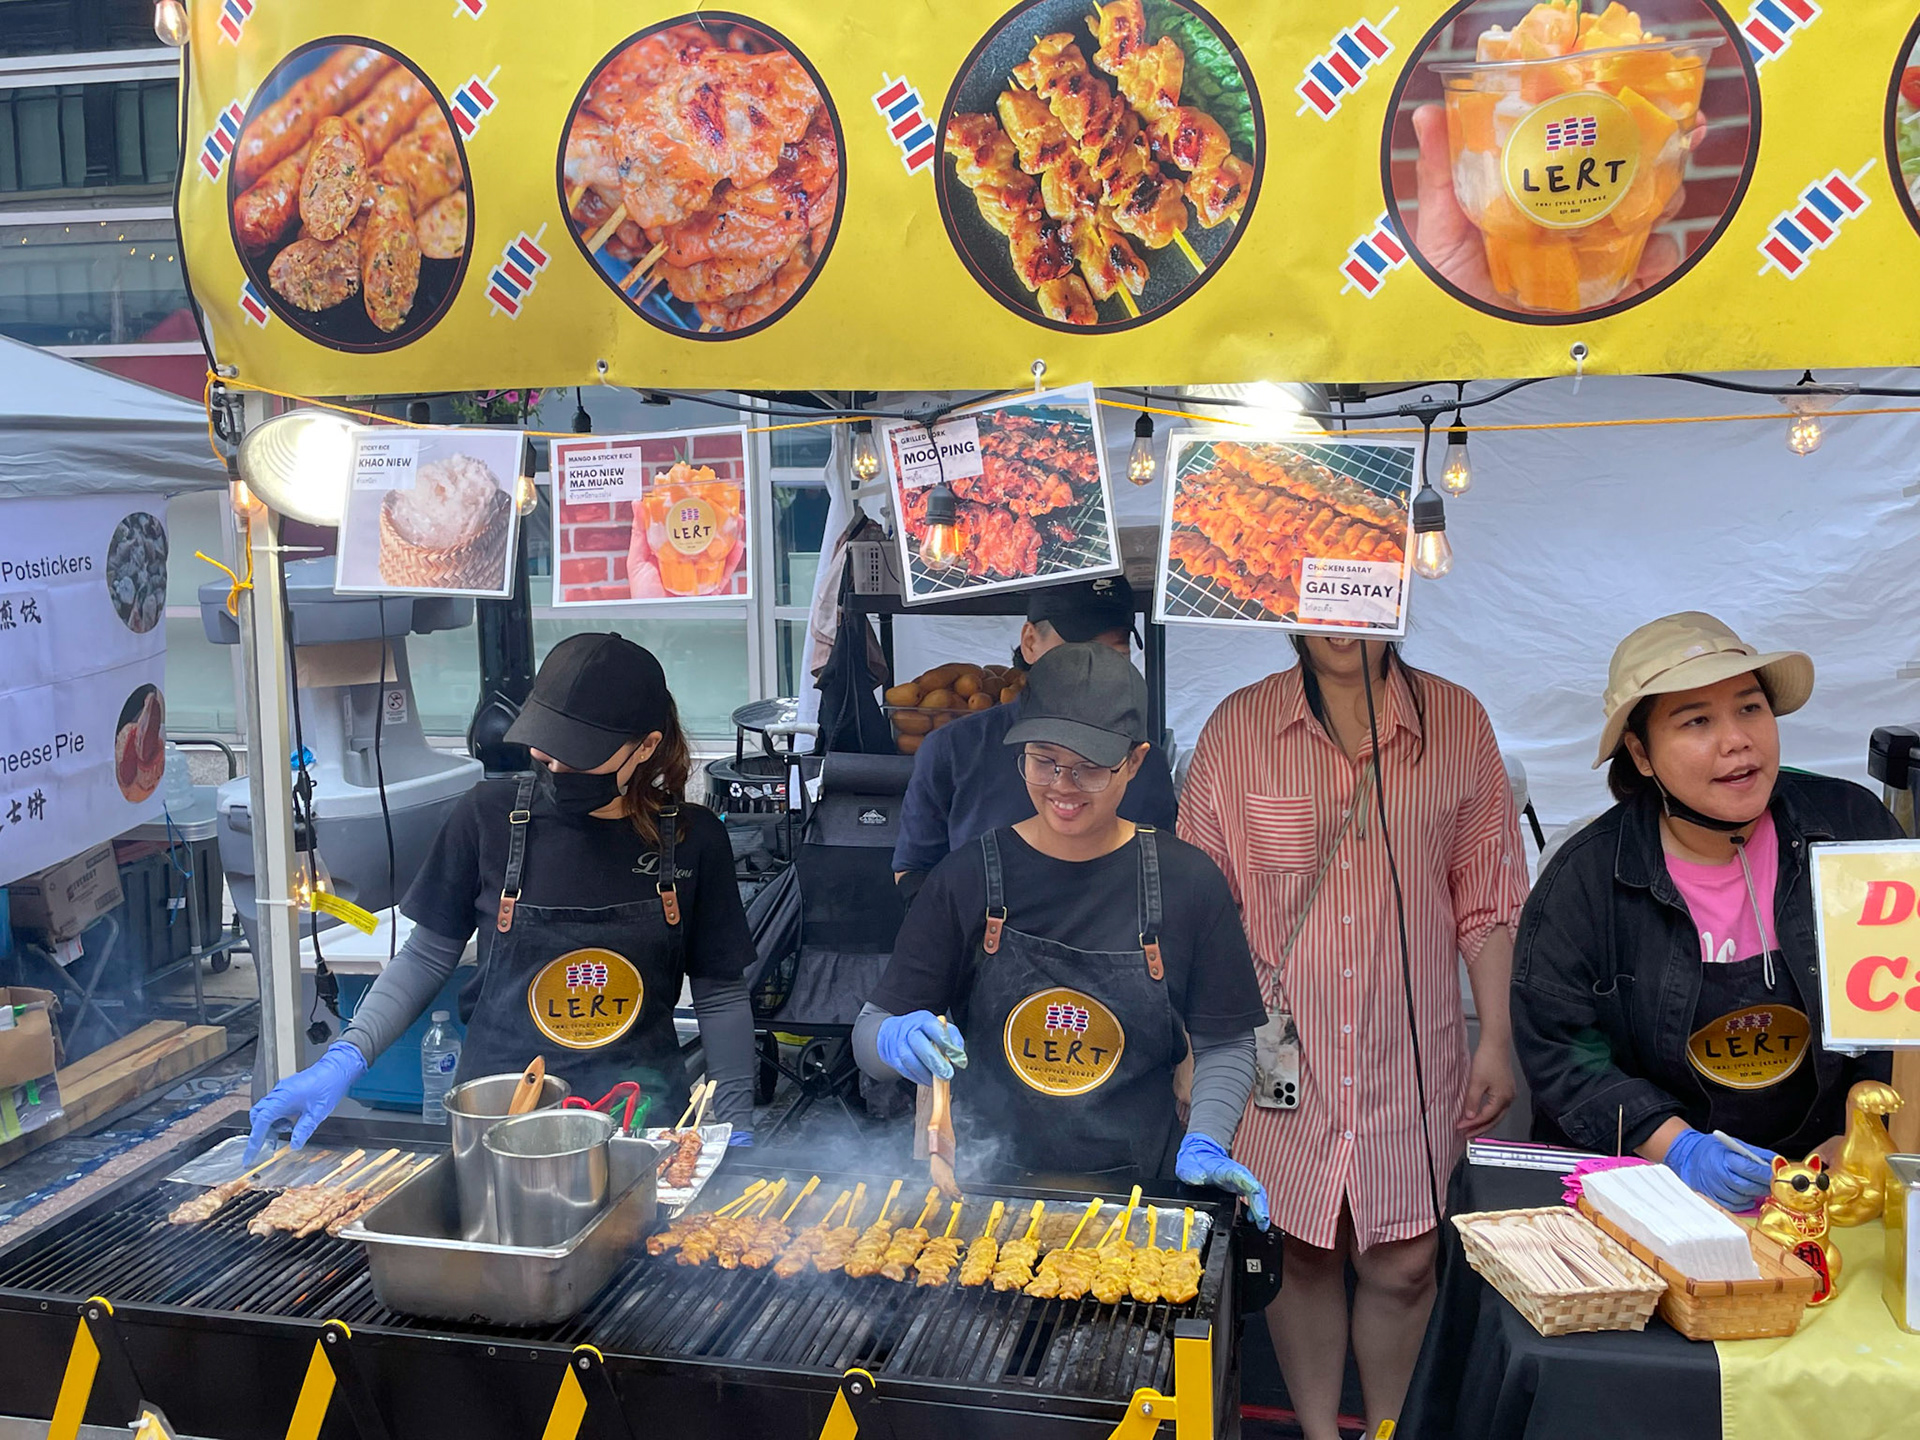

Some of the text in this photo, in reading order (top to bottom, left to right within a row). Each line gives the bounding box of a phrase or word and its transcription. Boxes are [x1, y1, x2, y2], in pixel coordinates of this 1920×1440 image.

[1523, 157, 1626, 193] LERT
[900, 434, 927, 444] GRILLED
[358, 457, 412, 468] KHAO NIEW
[904, 441, 975, 465] MOO PING
[569, 468, 625, 479] KHAO NIEW
[569, 477, 624, 488] MA MUANG
[673, 524, 711, 539] LERT
[1, 554, 92, 583] Potstickers
[1306, 581, 1394, 598] GAI SATAY
[55, 731, 84, 758] Pie
[548, 994, 629, 1018] LERT
[1023, 1038, 1109, 1065] LERT
[1705, 1032, 1799, 1058] LERT
[1249, 1261, 1259, 1271] R
